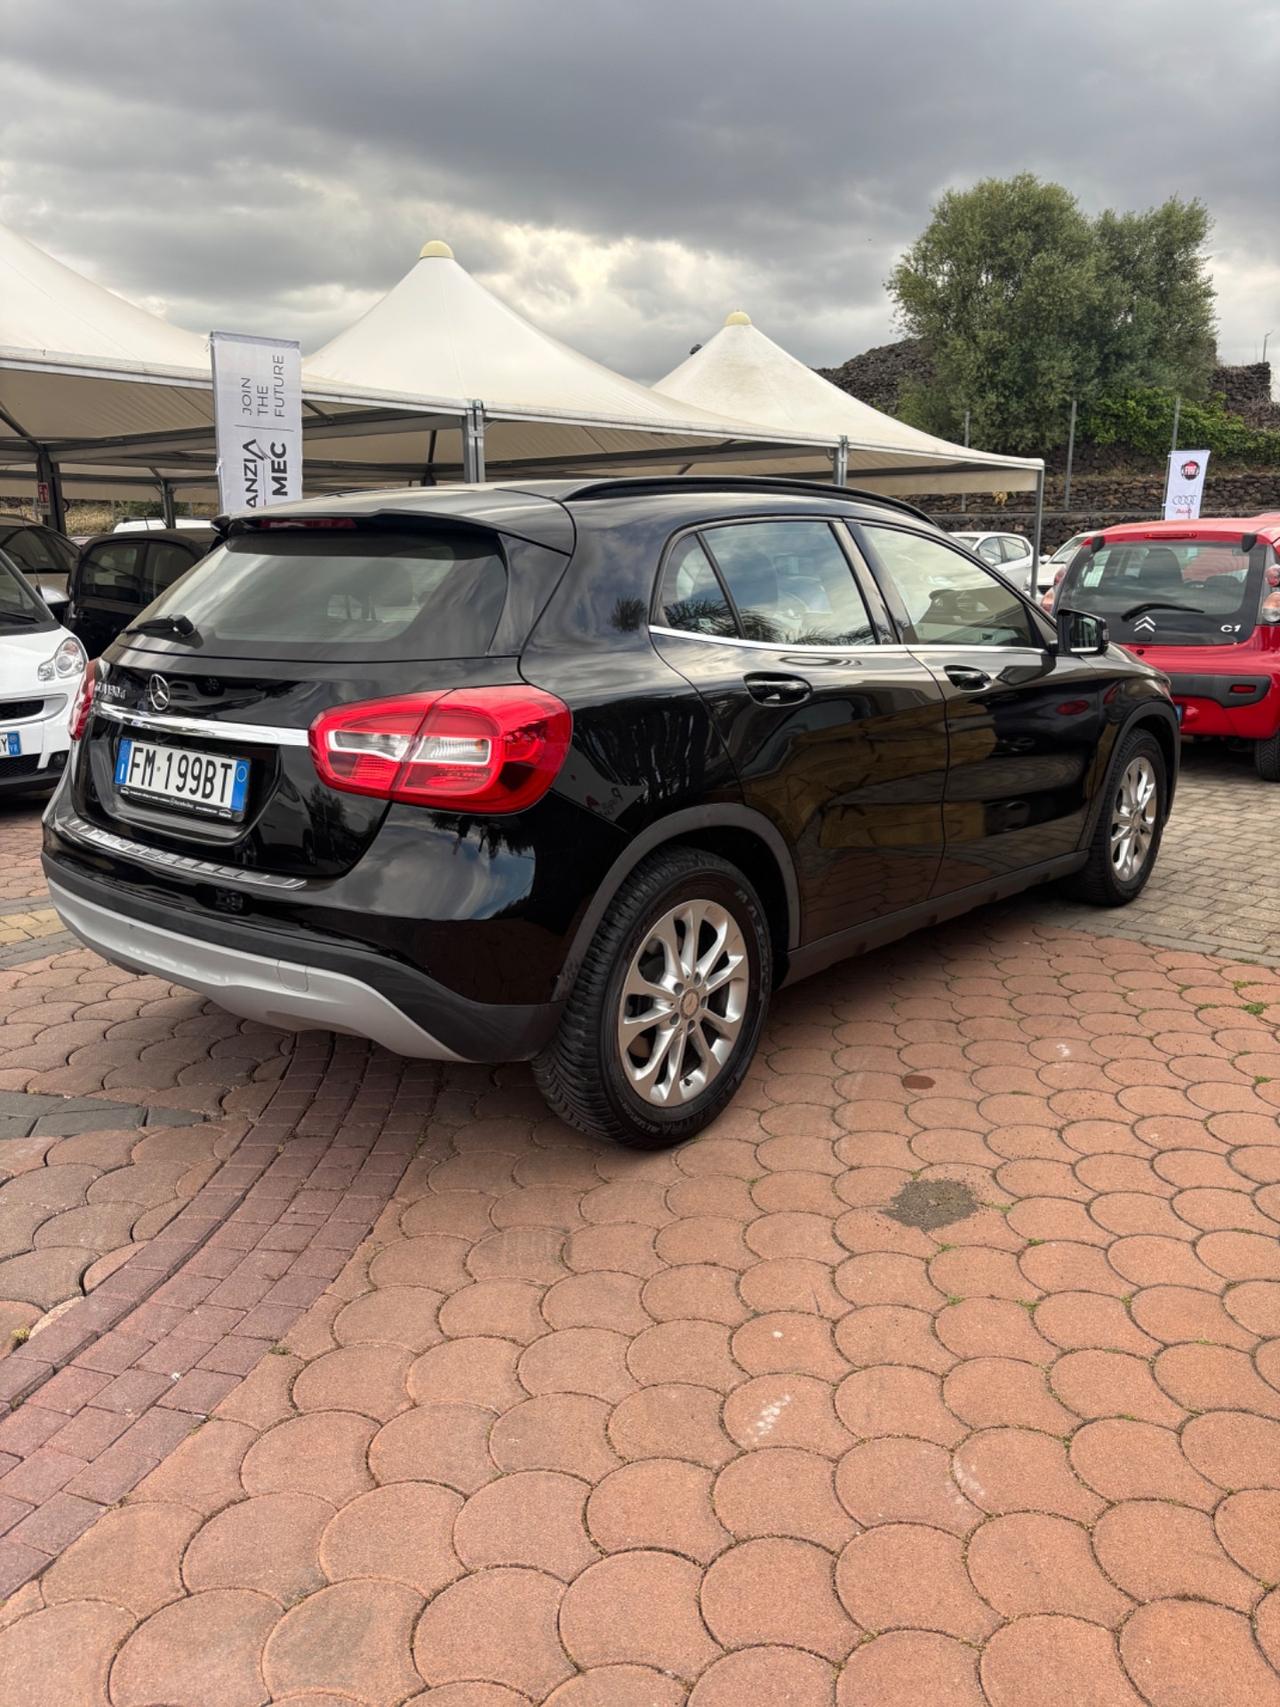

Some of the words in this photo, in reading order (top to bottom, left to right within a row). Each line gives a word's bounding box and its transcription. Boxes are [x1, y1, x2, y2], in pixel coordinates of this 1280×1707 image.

[241, 377, 252, 416] JOIN
[257, 385, 269, 417] THE
[272, 354, 285, 418] FUTURE
[270, 442, 288, 497] MEC
[1220, 624, 1241, 632] C1
[129, 747, 157, 787] FM
[164, 752, 233, 803] 199BT
